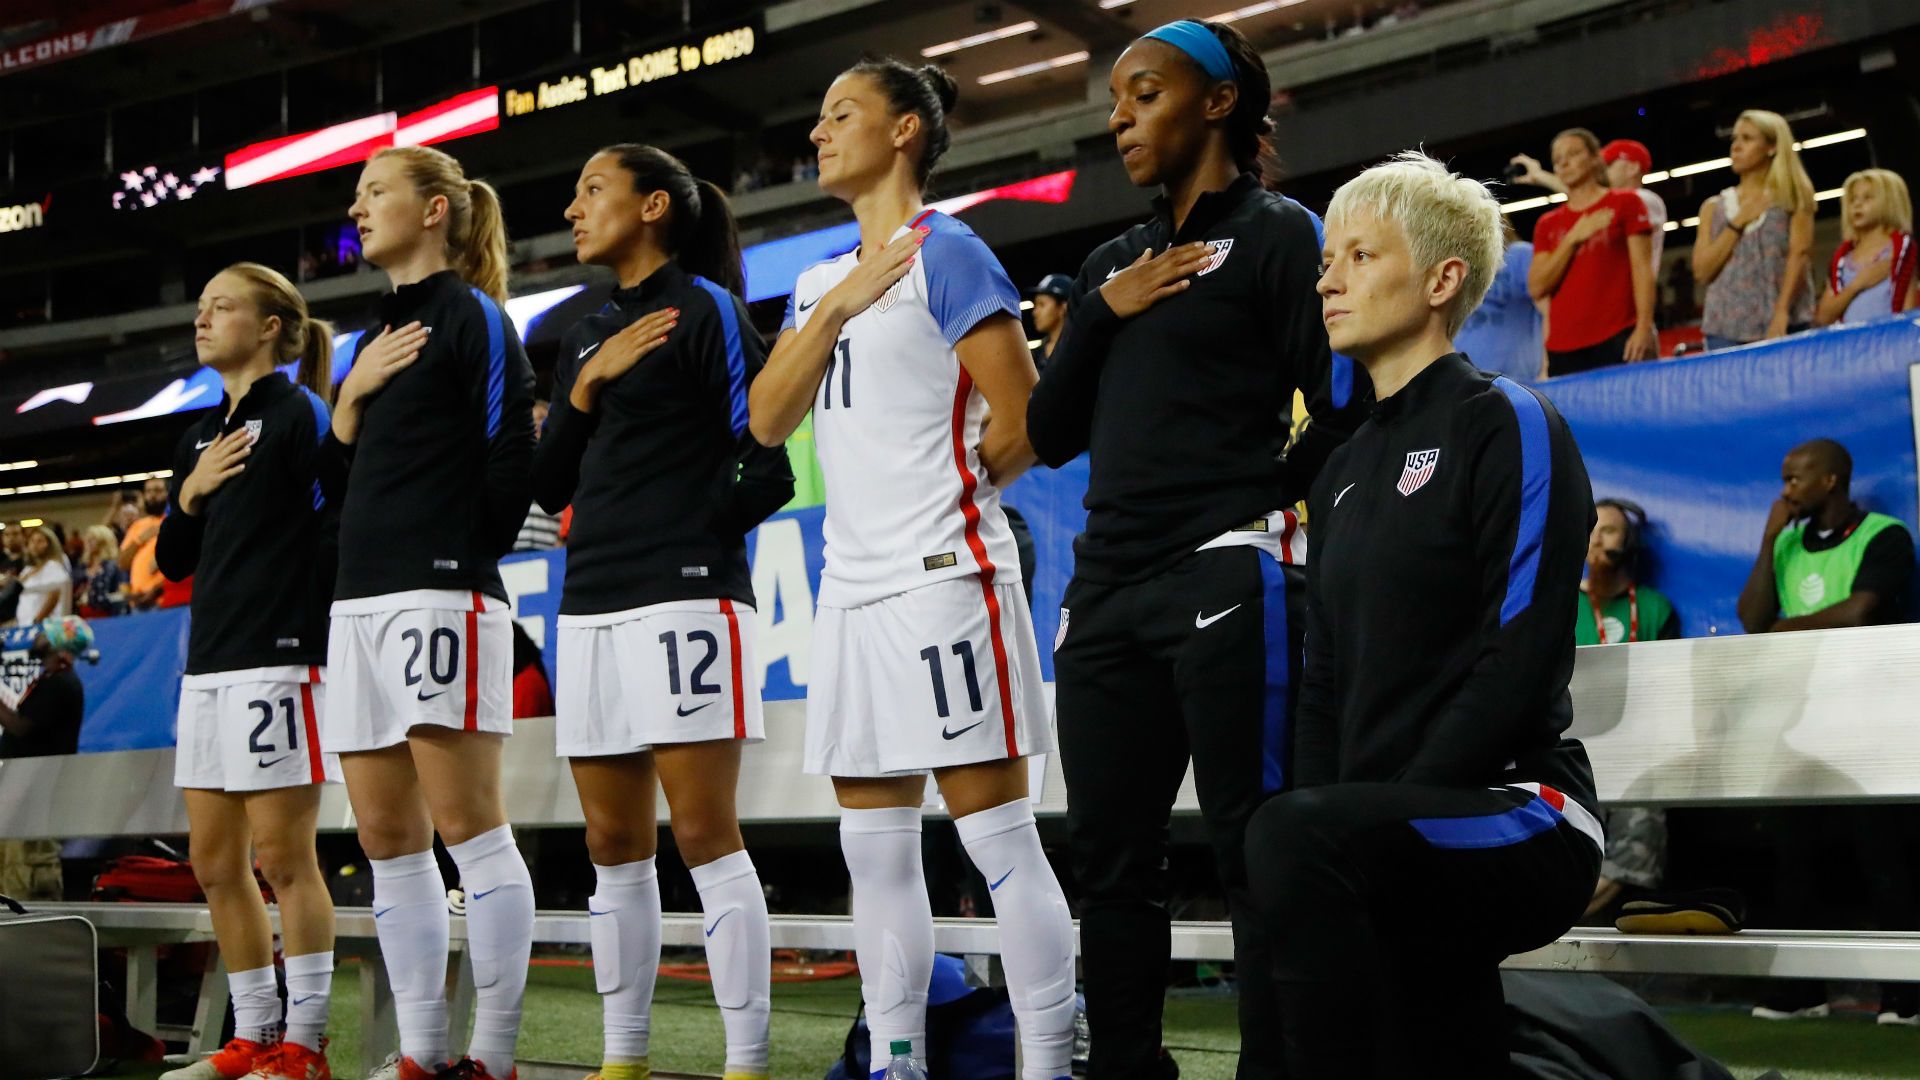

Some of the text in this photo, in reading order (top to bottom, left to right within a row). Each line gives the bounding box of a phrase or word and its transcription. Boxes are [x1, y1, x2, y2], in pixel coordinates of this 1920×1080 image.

[0, 31, 88, 71] LCONS
[506, 89, 535, 117] Fan
[591, 62, 627, 96] Text
[628, 47, 678, 86] DOME
[680, 45, 700, 72] to
[1407, 450, 1438, 470] USA
[401, 626, 460, 687] 20
[658, 629, 722, 695] 12
[919, 639, 984, 718] 11
[247, 696, 299, 754] 21
